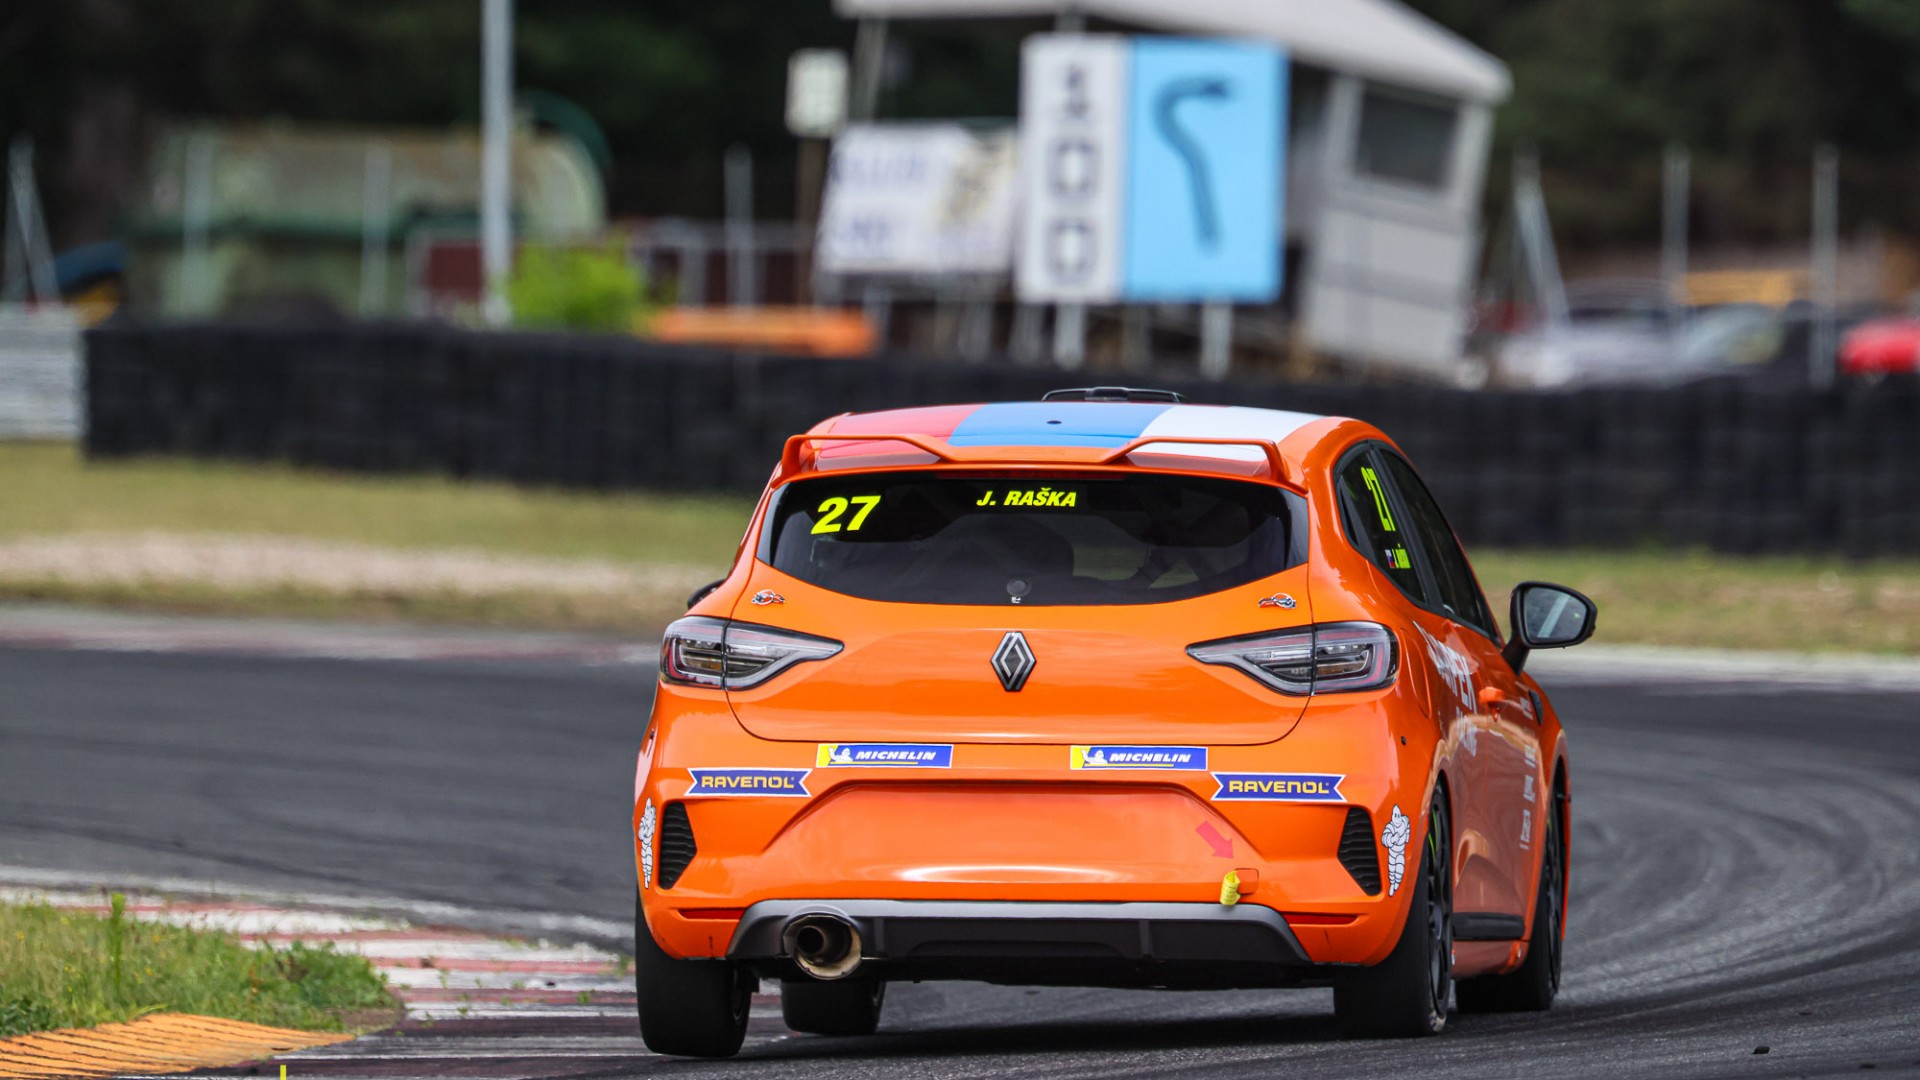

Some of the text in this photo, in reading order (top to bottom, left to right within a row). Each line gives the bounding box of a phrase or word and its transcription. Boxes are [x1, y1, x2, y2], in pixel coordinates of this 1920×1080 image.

[976, 487, 1077, 507] J. RAŠKA
[1361, 466, 1396, 532] 27
[810, 495, 882, 535] 27
[855, 750, 937, 761] MICHELIN
[1109, 751, 1191, 763] MICHELIN
[701, 775, 795, 789] RAVENOL
[1228, 780, 1330, 795] RAVENOL
